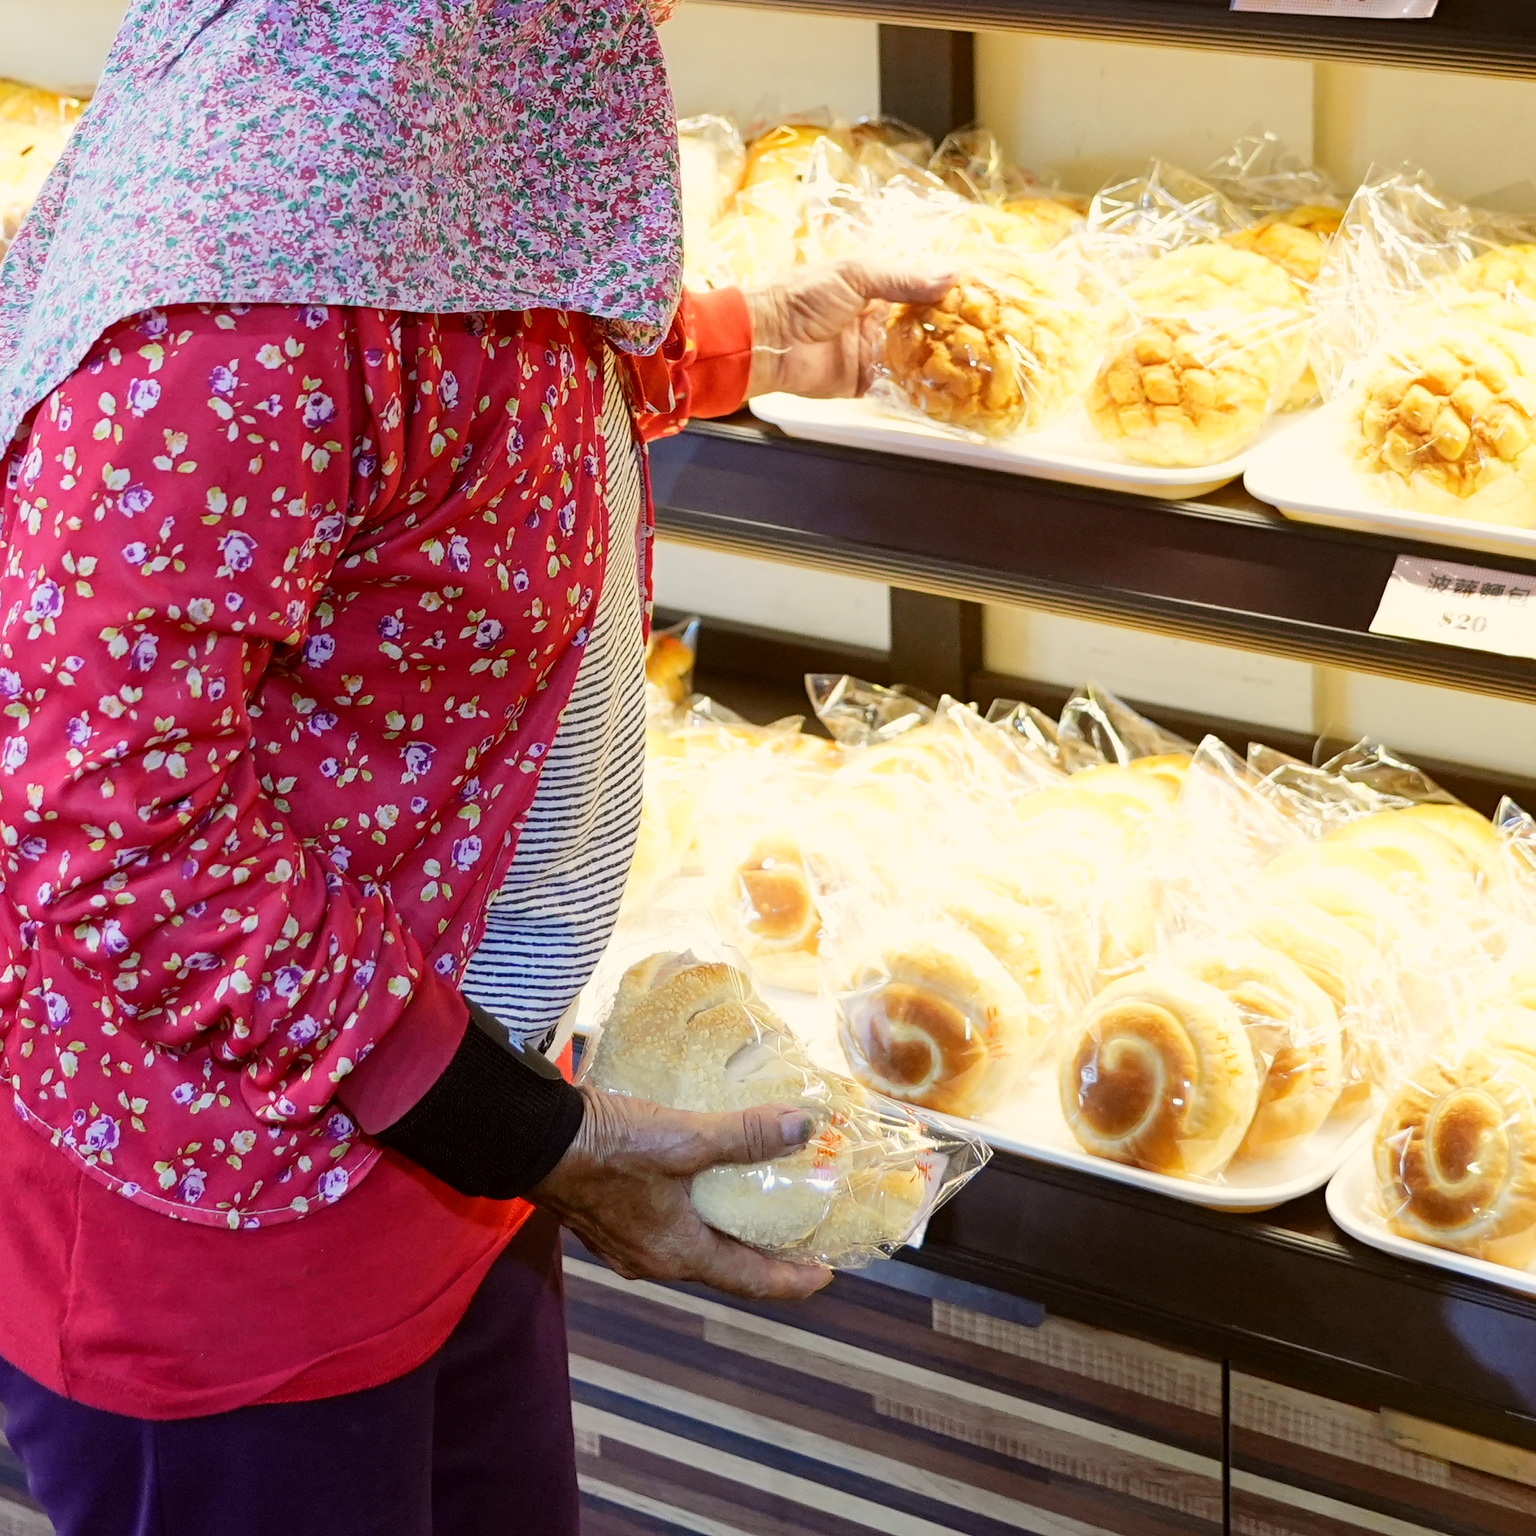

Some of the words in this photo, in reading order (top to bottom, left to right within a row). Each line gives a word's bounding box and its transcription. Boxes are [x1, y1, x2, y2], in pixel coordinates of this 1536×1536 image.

[1426, 572, 1531, 607] 波蘿麵包
[1438, 611, 1488, 633] $20
